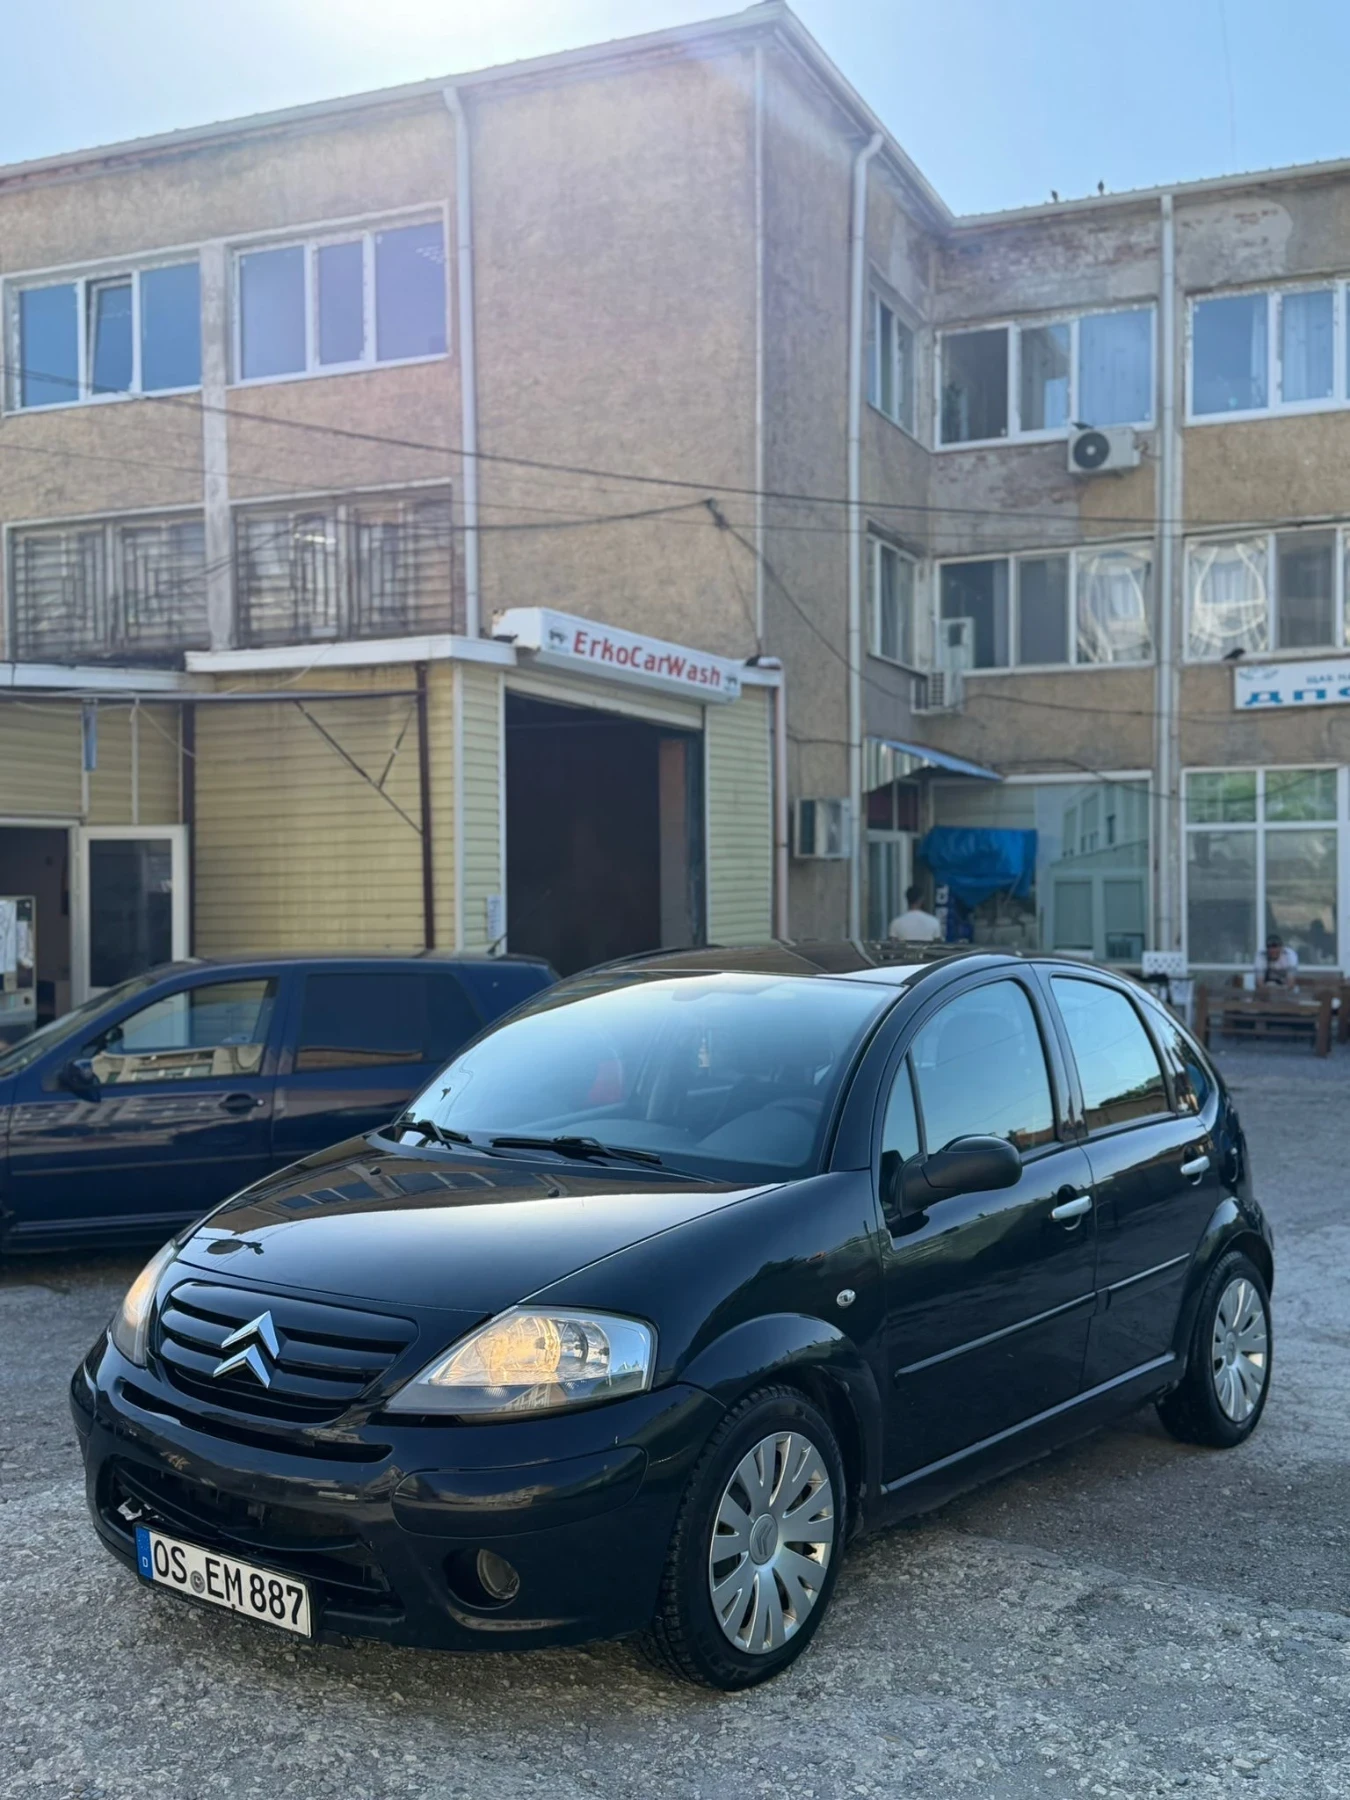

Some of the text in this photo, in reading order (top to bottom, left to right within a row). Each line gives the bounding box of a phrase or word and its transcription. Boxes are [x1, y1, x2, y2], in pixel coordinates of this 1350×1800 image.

[573, 630, 721, 687] ErkoCarWash
[142, 1556, 149, 1568] D
[154, 1539, 304, 1625] OS EM 887
